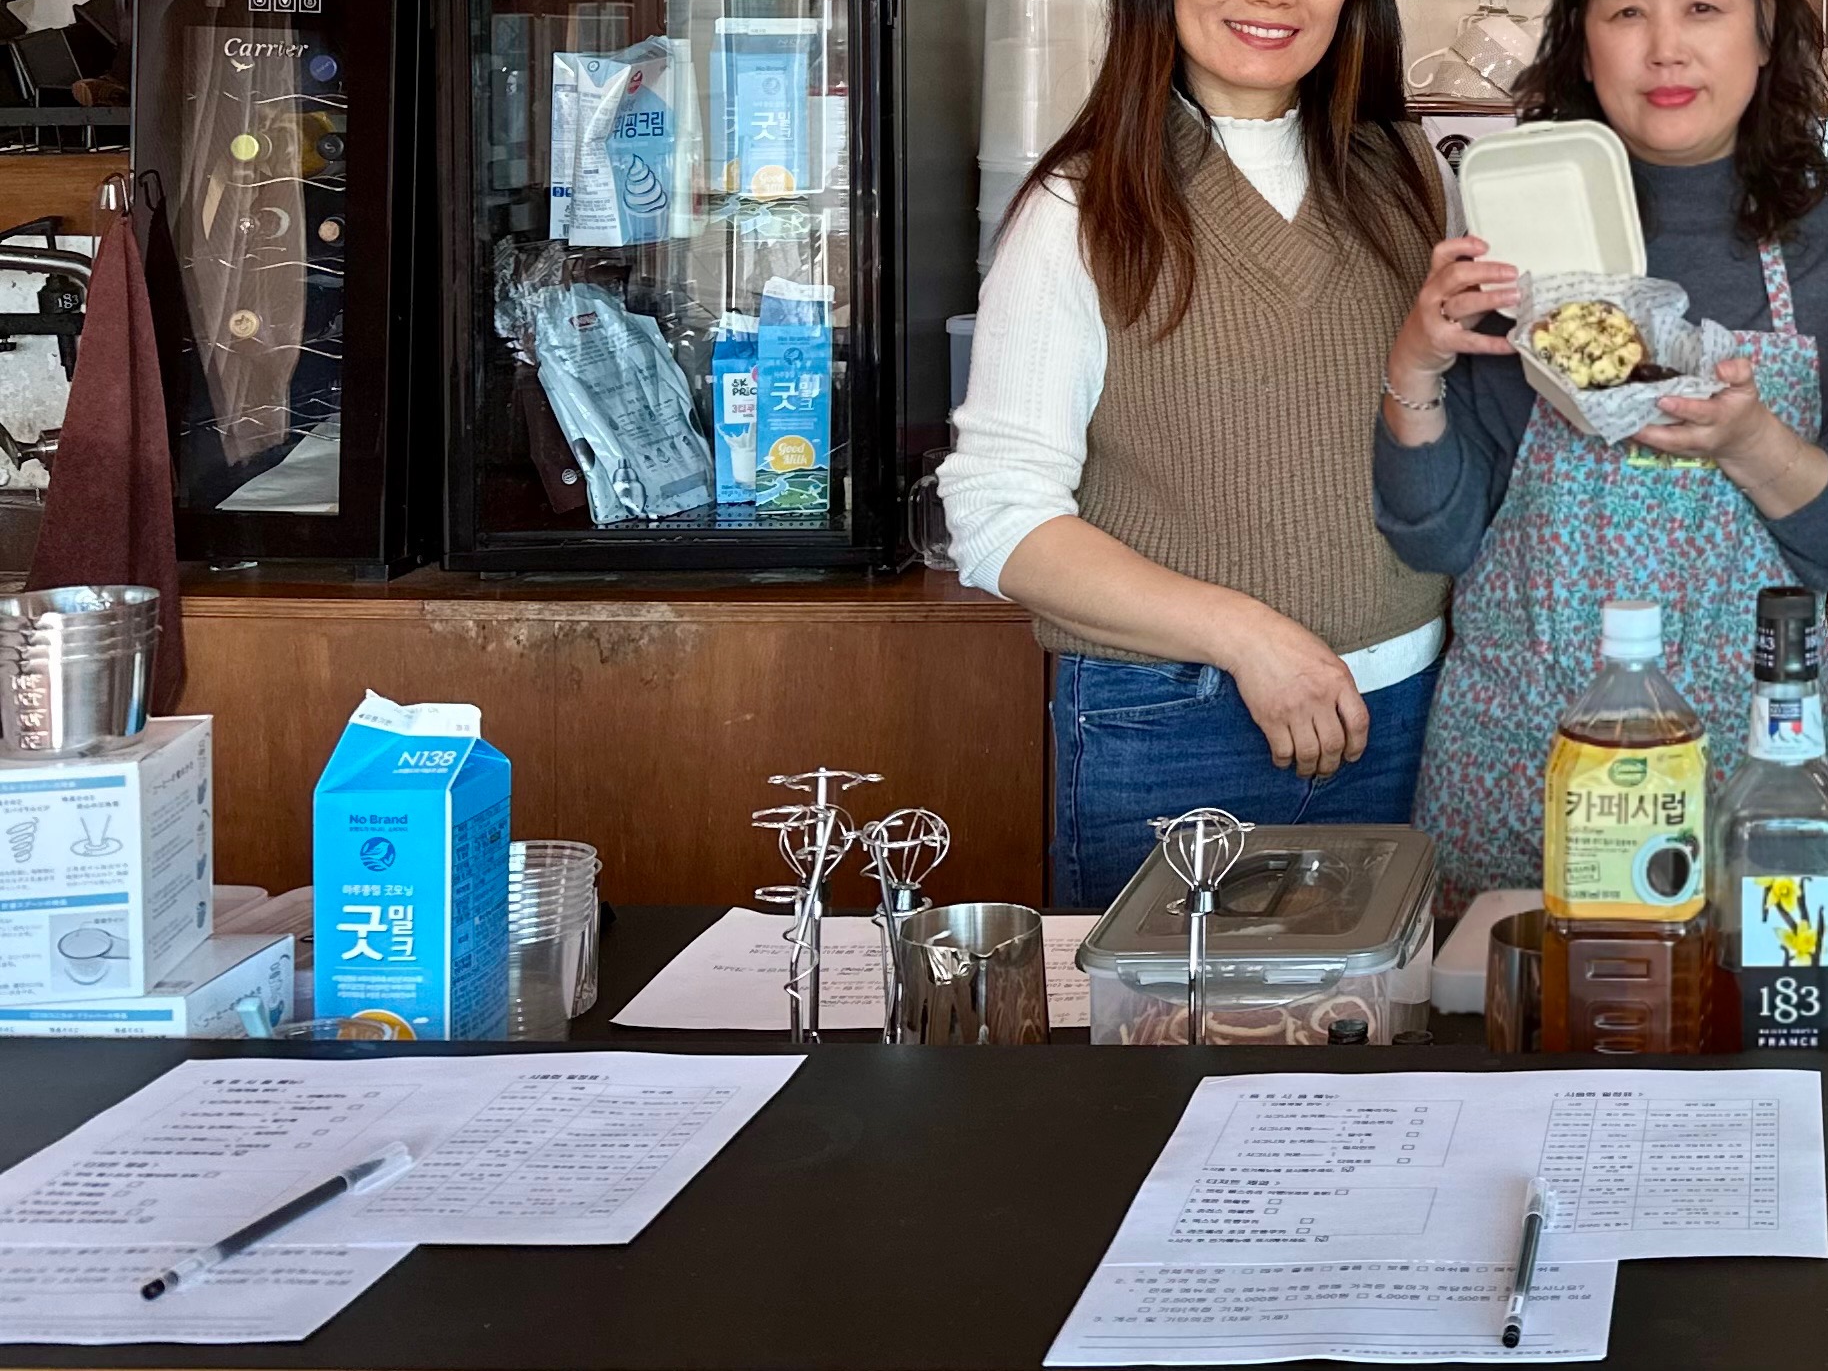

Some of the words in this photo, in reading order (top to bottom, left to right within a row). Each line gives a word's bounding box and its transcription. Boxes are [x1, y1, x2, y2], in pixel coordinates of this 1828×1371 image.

[224, 37, 309, 58] Carrier
[57, 293, 79, 309] 183
[778, 442, 805, 456] Good
[783, 453, 808, 466] Milk
[398, 750, 457, 767] N138
[1565, 790, 1687, 827] 카페시럽
[350, 814, 367, 825] No
[369, 814, 408, 825] Brand
[1759, 976, 1821, 1023] 183
[1758, 1036, 1819, 1047] FRANCE
